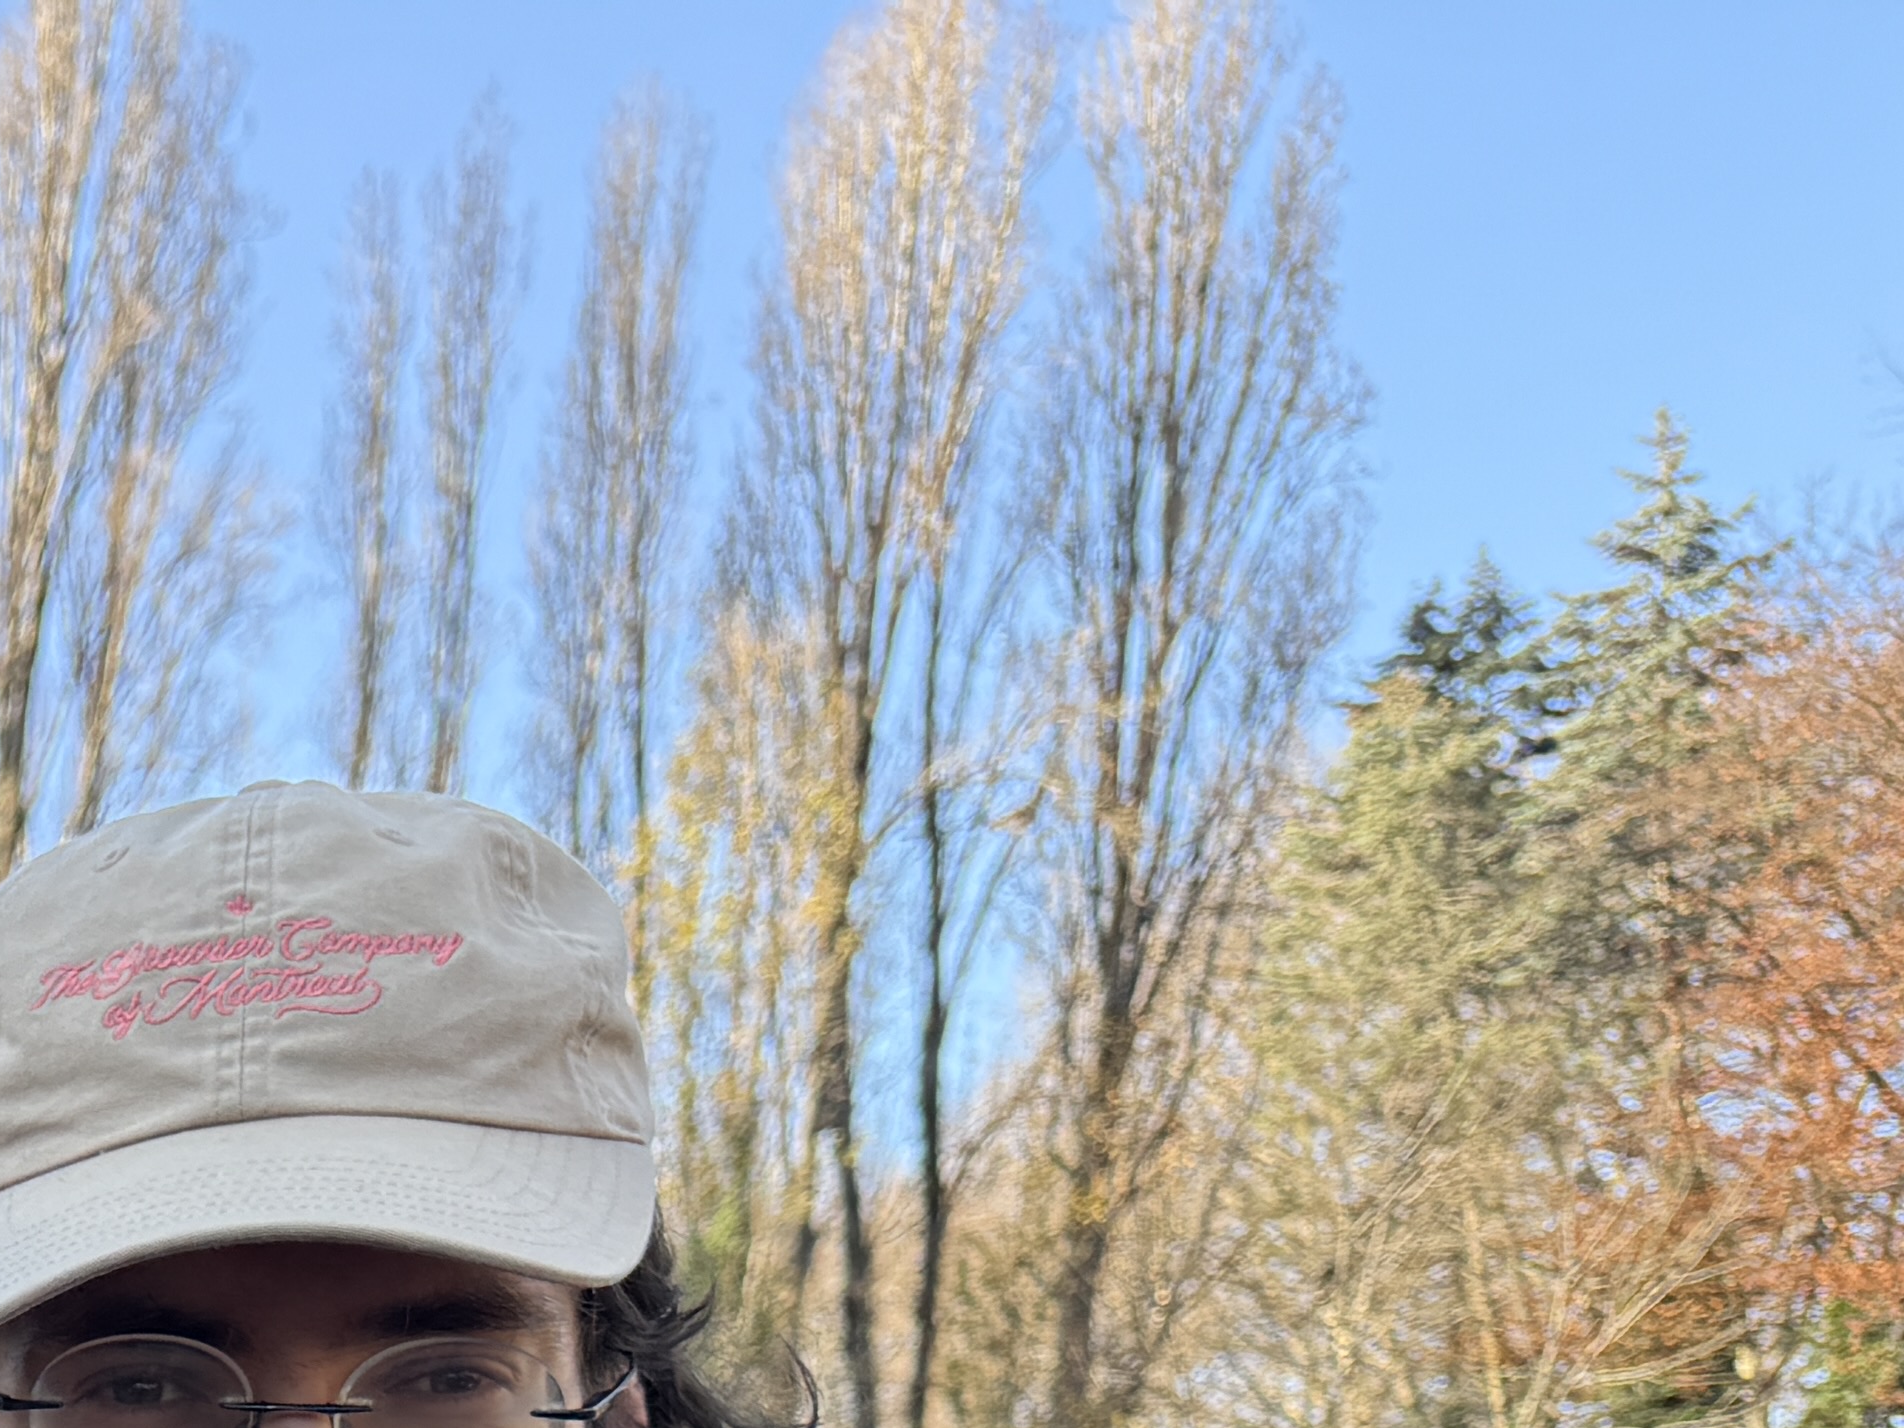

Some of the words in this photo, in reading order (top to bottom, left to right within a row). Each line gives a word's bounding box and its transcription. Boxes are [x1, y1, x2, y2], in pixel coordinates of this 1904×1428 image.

[29, 957, 101, 1011] The
[92, 935, 274, 1001] Browser
[276, 916, 464, 966] Company
[101, 990, 143, 1041] of
[143, 963, 383, 1026] Montreal
